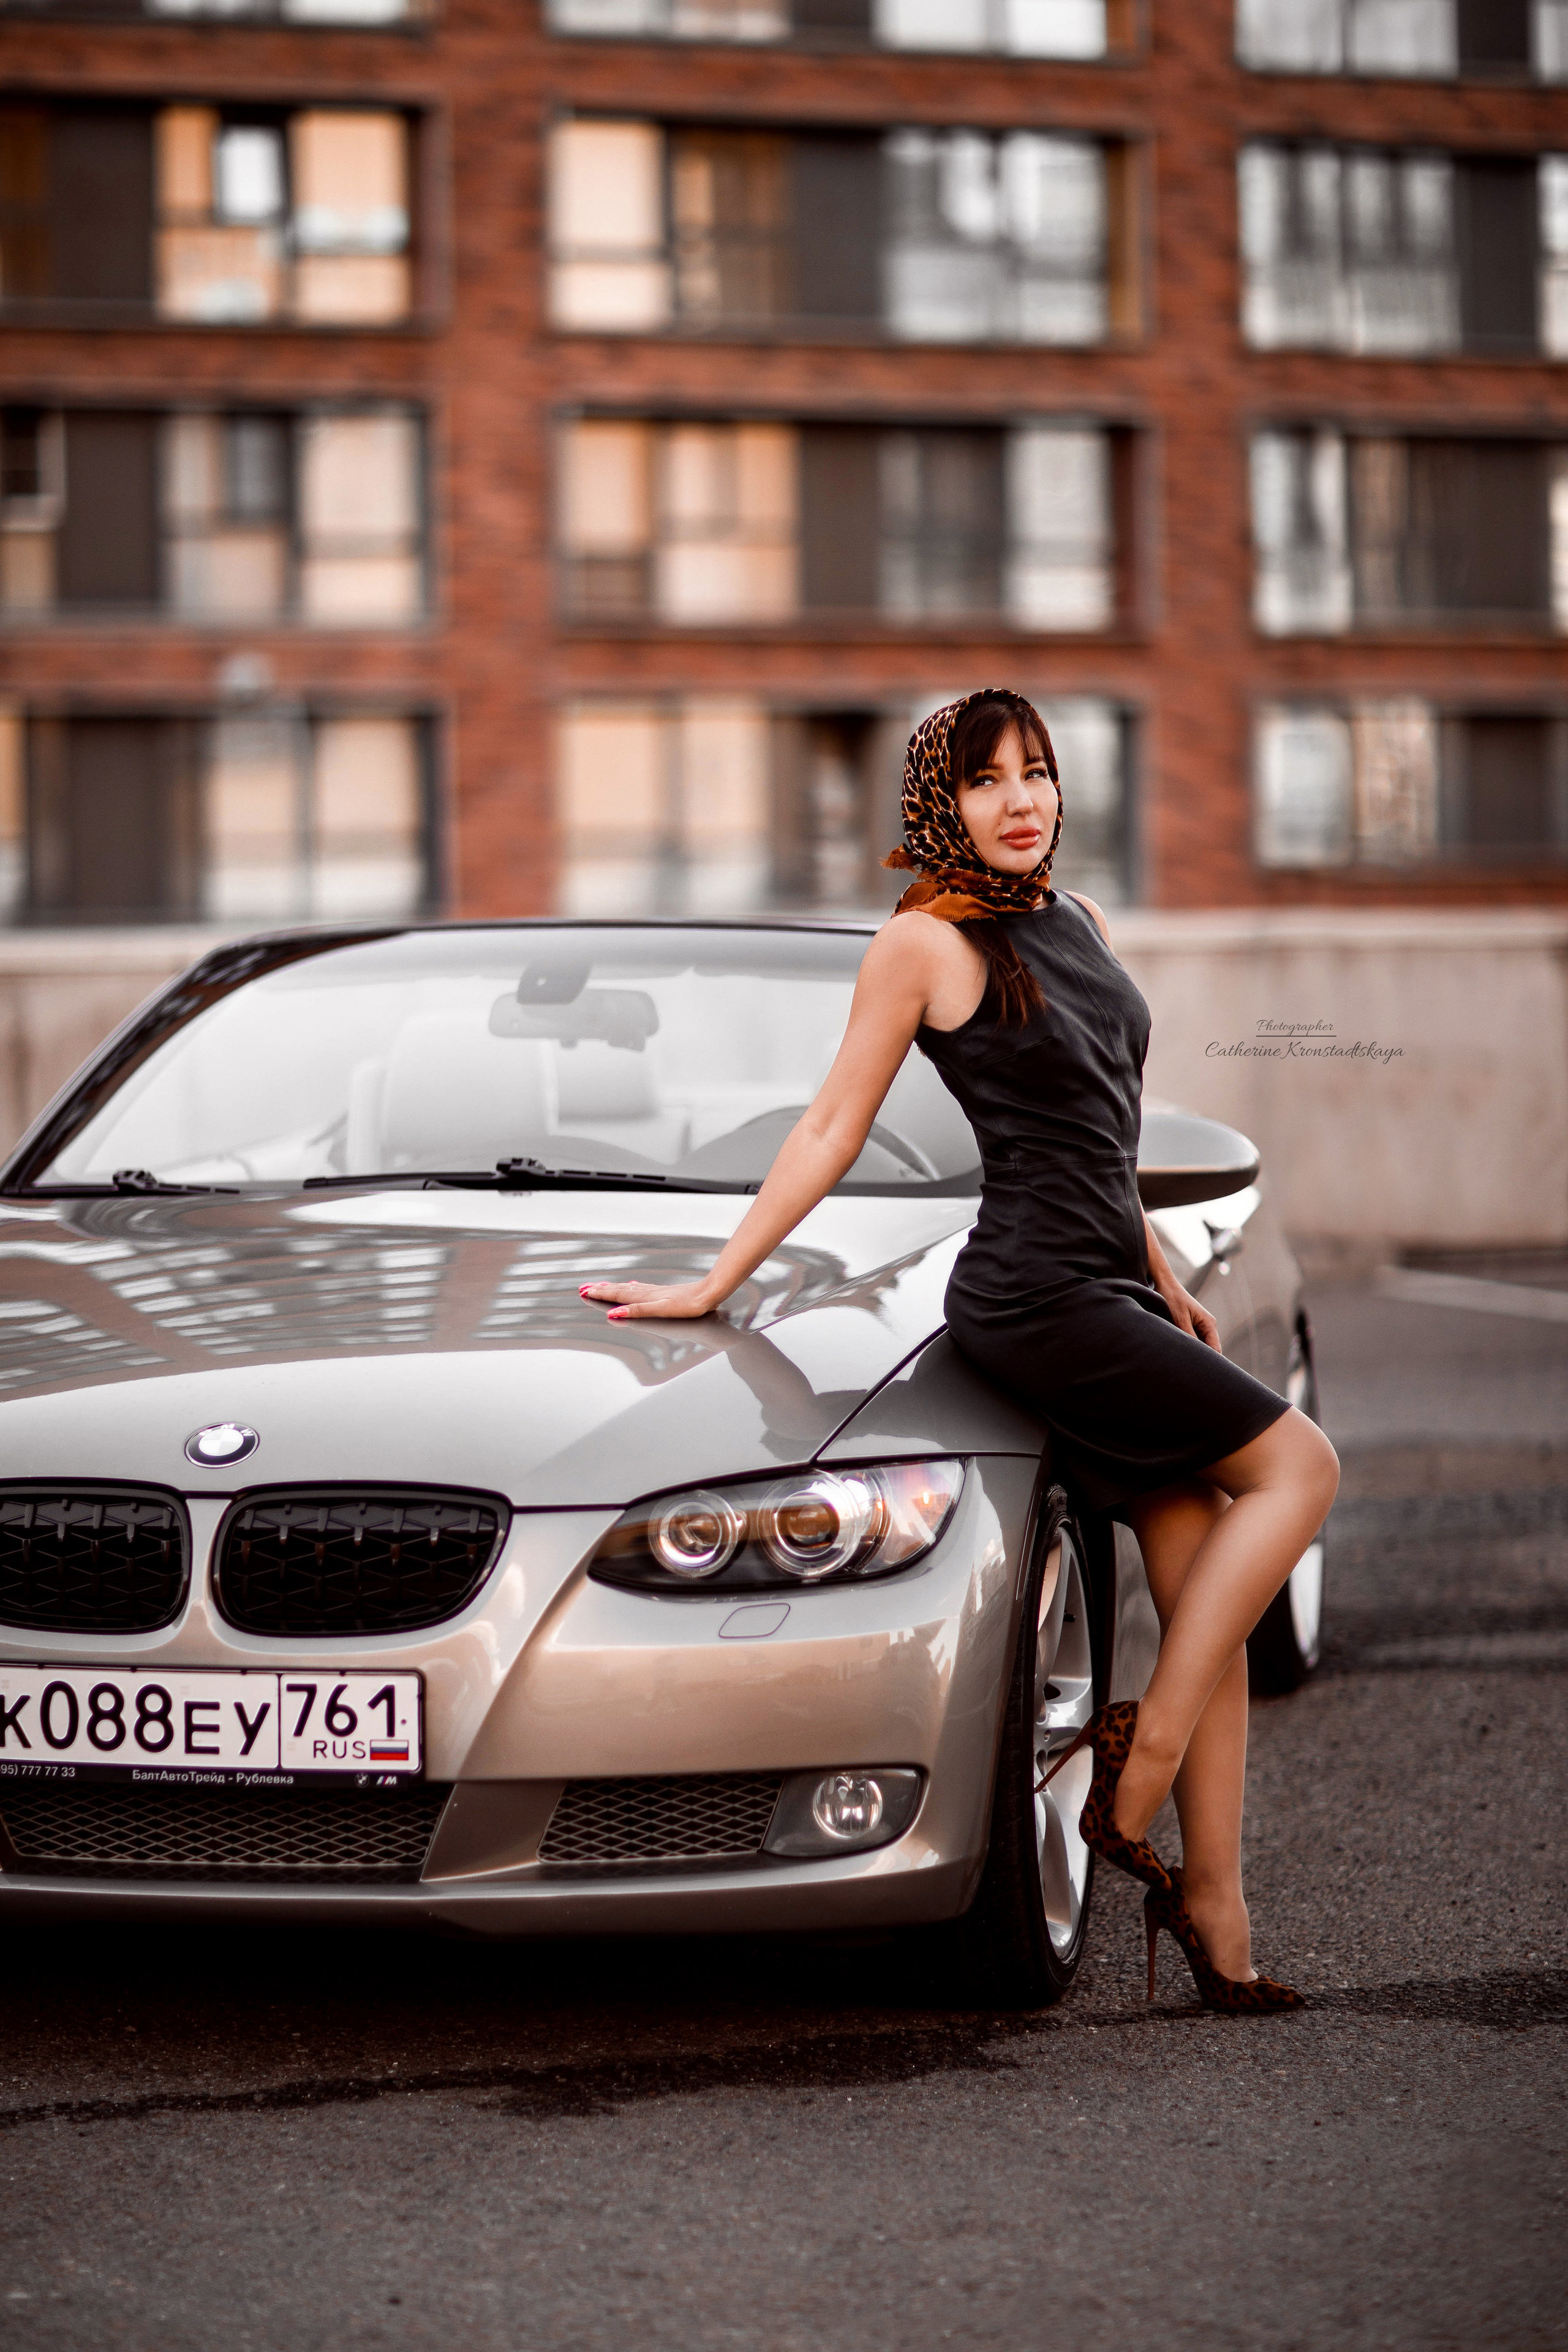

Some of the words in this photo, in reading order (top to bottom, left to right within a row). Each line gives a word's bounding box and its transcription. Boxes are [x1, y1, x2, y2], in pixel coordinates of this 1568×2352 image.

[198, 1423, 254, 1437] BMW
[286, 1684, 395, 1738] 761
[313, 1740, 366, 1759] RUS
[0, 1764, 18, 1776] 95)
[21, 1765, 41, 1776] 777
[44, 1766, 58, 1776] 77
[61, 1767, 75, 1777] 33
[132, 1770, 225, 1784] БалтАвтоТрейд
[236, 1773, 294, 1785] Рублевка
